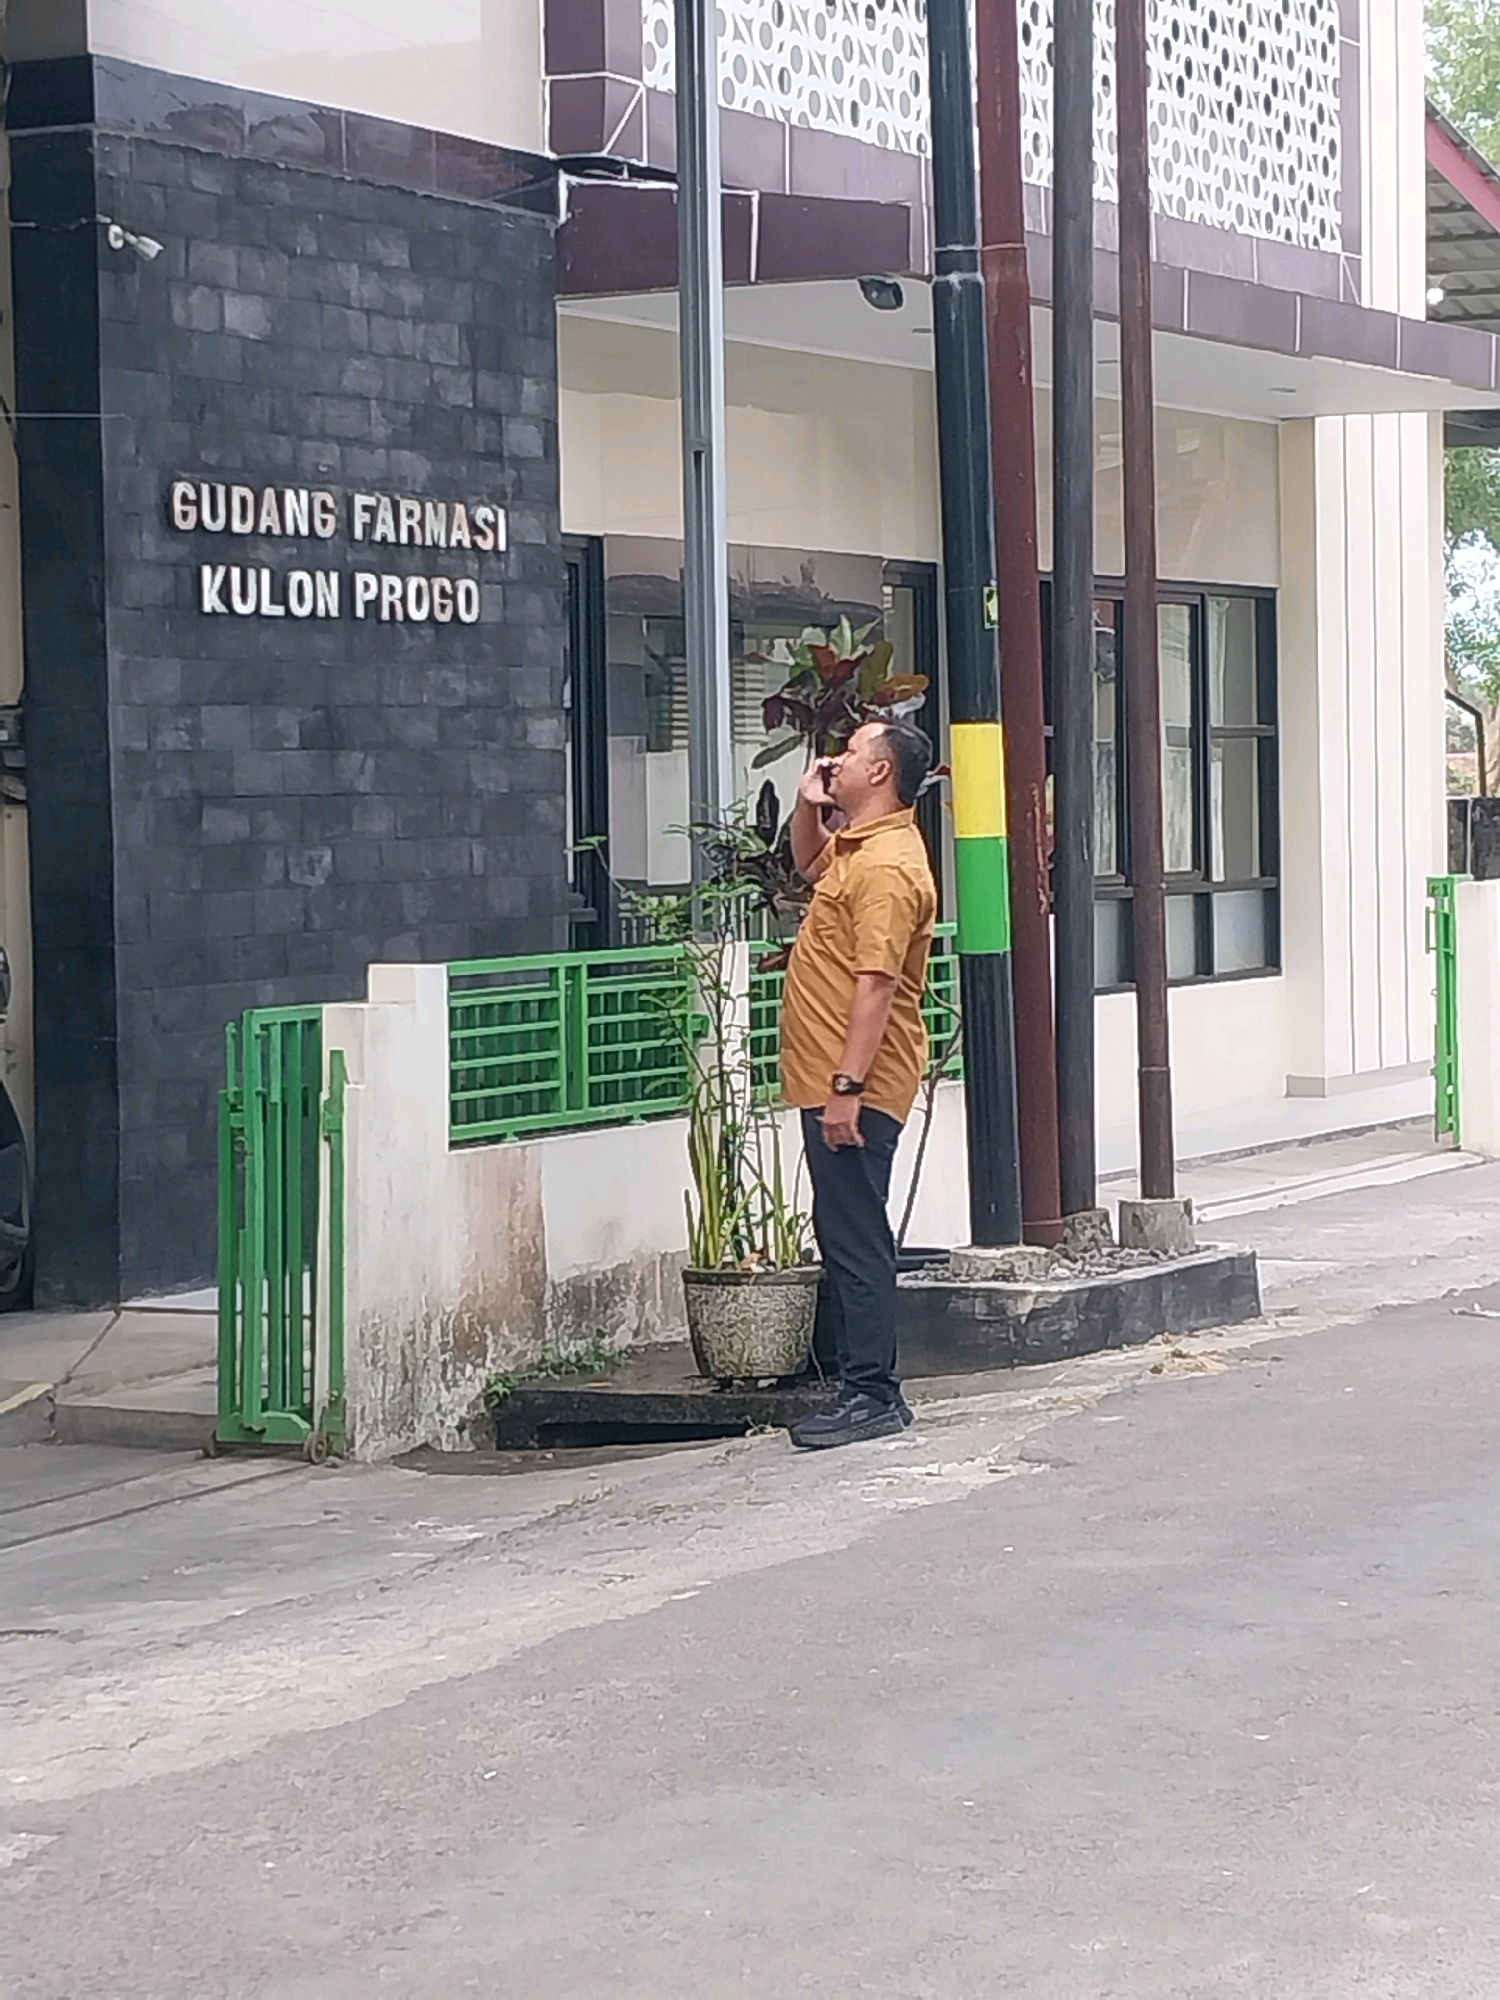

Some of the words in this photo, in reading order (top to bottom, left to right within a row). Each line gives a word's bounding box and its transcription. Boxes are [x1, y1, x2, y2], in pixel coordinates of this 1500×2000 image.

[172, 481, 336, 538] GUDANG
[354, 493, 507, 551] FARMASI
[201, 564, 339, 618] KULON
[355, 572, 480, 623] PROGO
